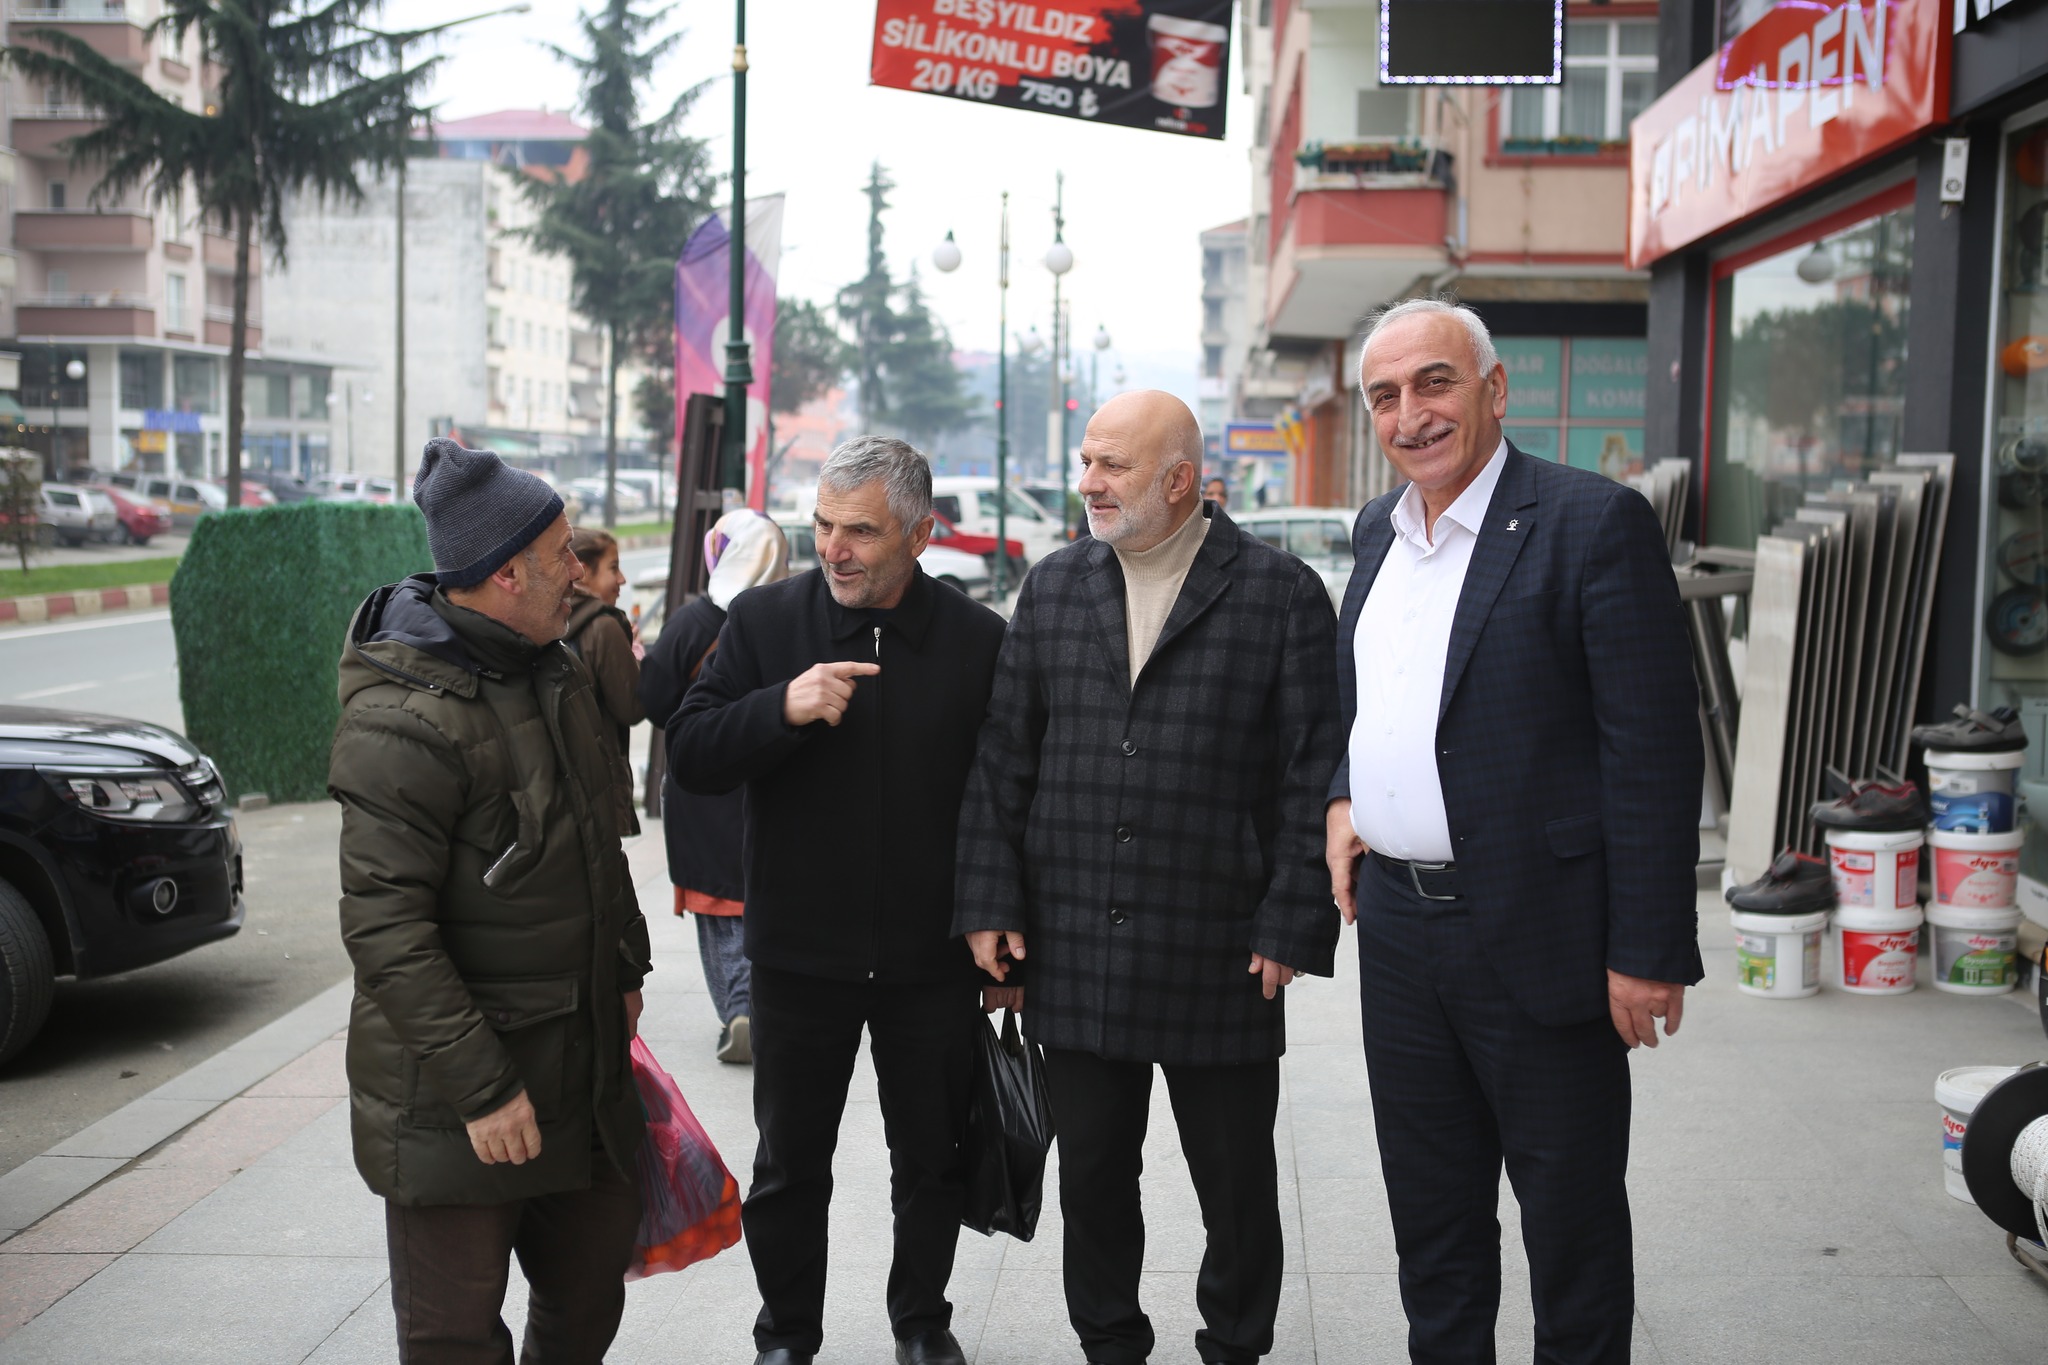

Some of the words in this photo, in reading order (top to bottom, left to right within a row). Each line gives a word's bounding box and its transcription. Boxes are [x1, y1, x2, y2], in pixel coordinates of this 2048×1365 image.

[933, 0, 1095, 44] BEŞYILDIZ
[881, 14, 1049, 73] SİLİKONLU
[1051, 49, 1132, 90] BOYA
[910, 57, 954, 93] 20
[954, 65, 1000, 100] KG
[1019, 79, 1074, 109] 750
[1970, 857, 1999, 871] dyo
[1879, 936, 1908, 951] dyo
[1968, 933, 1997, 950] dyo
[1943, 1114, 1967, 1135] dyo
